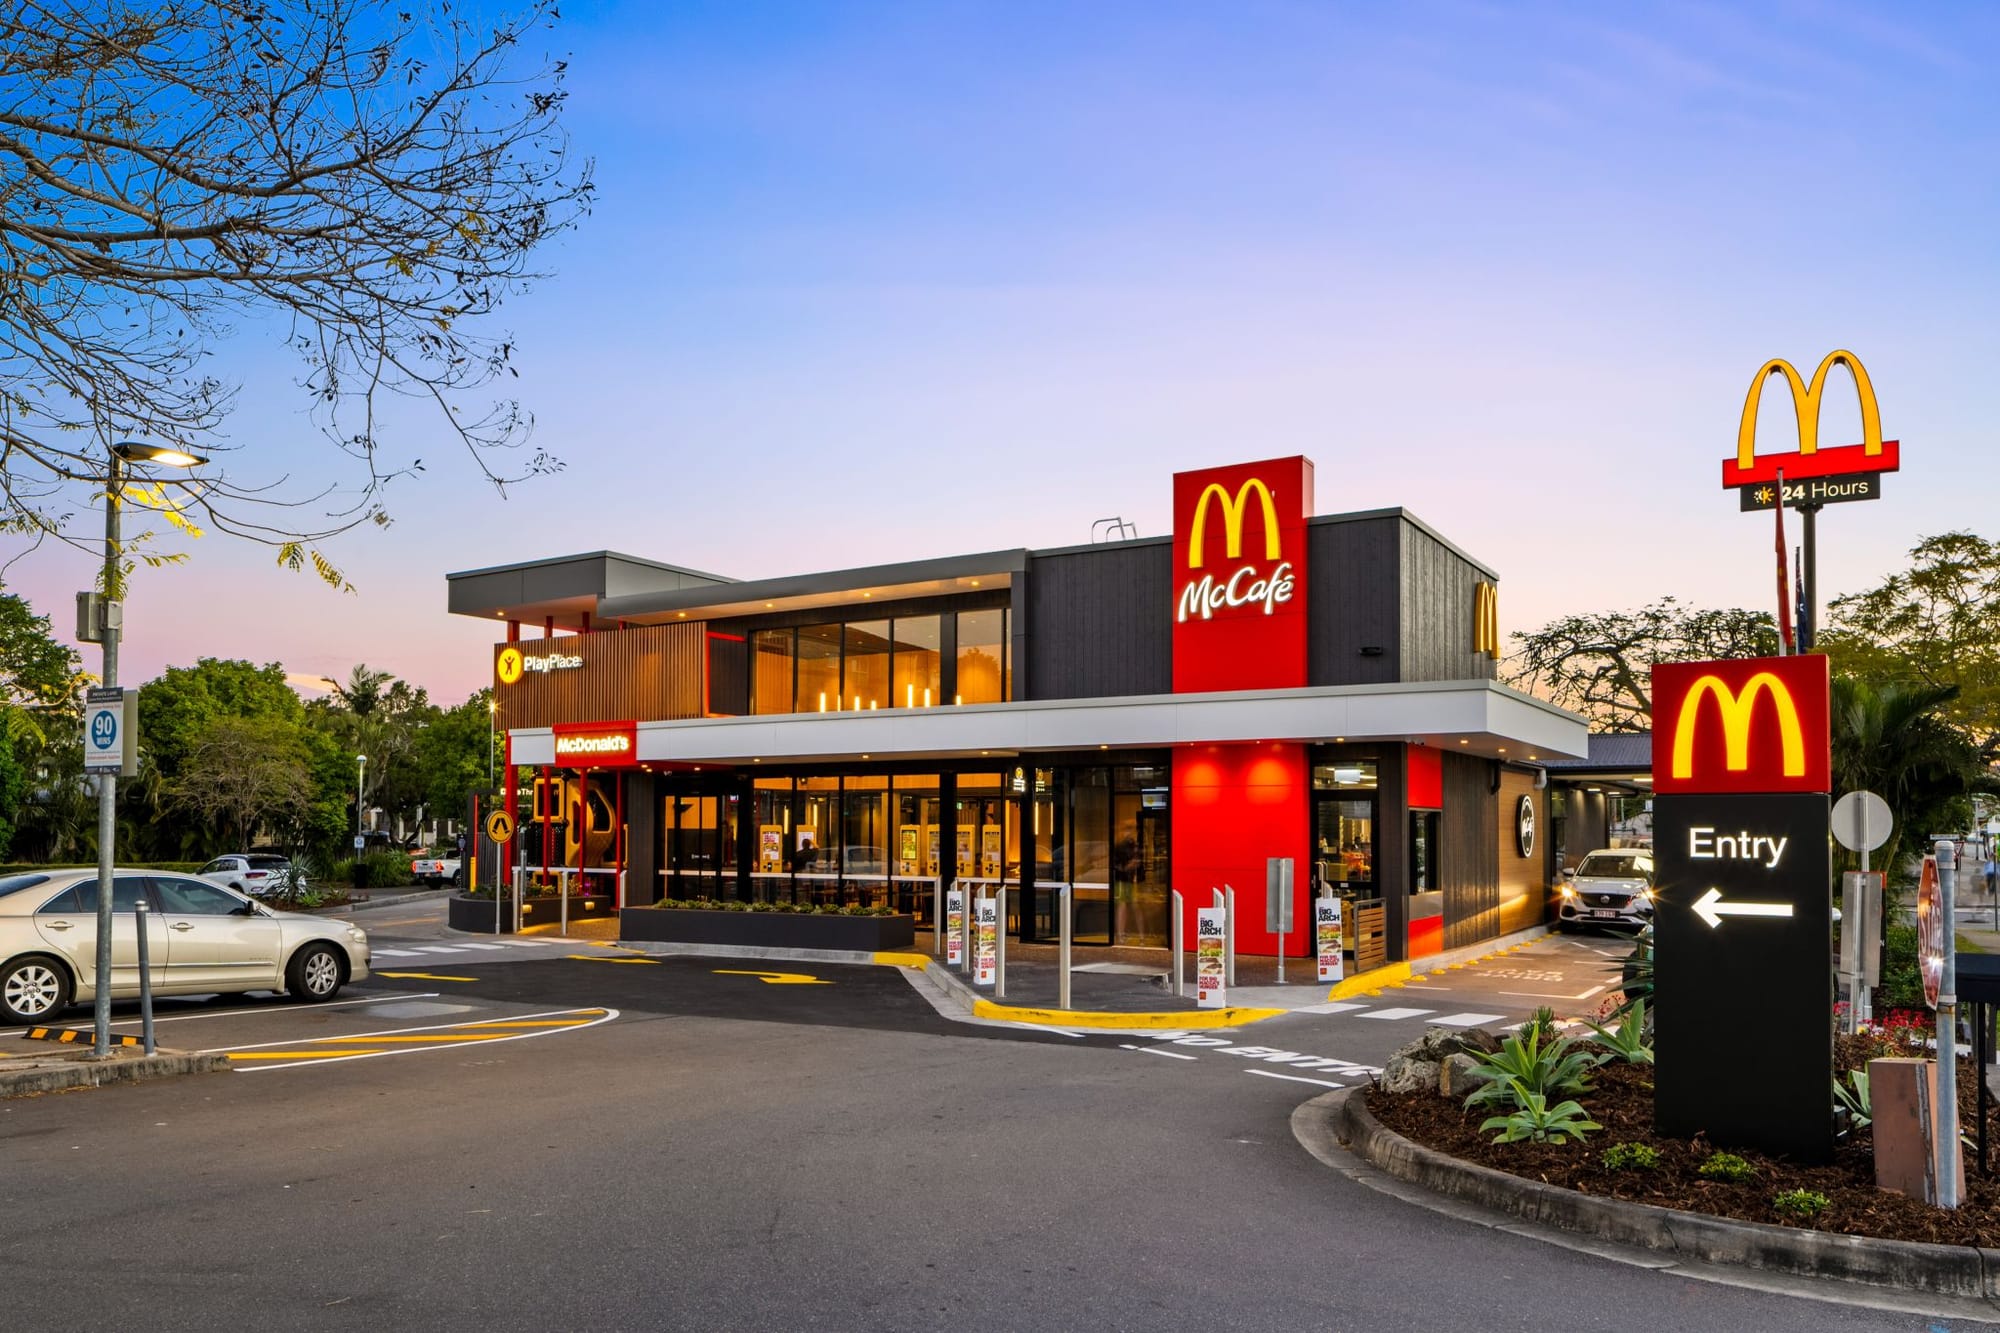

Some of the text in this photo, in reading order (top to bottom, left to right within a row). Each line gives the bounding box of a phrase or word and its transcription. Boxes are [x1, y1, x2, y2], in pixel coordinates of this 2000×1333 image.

[1782, 481, 1869, 501] 24 Hours
[1178, 562, 1295, 623] McCafé
[524, 653, 583, 672] PlayPlace
[96, 716, 112, 735] 90
[556, 735, 629, 753] McDonald's
[1689, 827, 1788, 868] Entry
[1199, 927, 1222, 936] ARCH
[1200, 920, 1214, 928] BIG
[1213, 1046, 1385, 1077] ENTR
